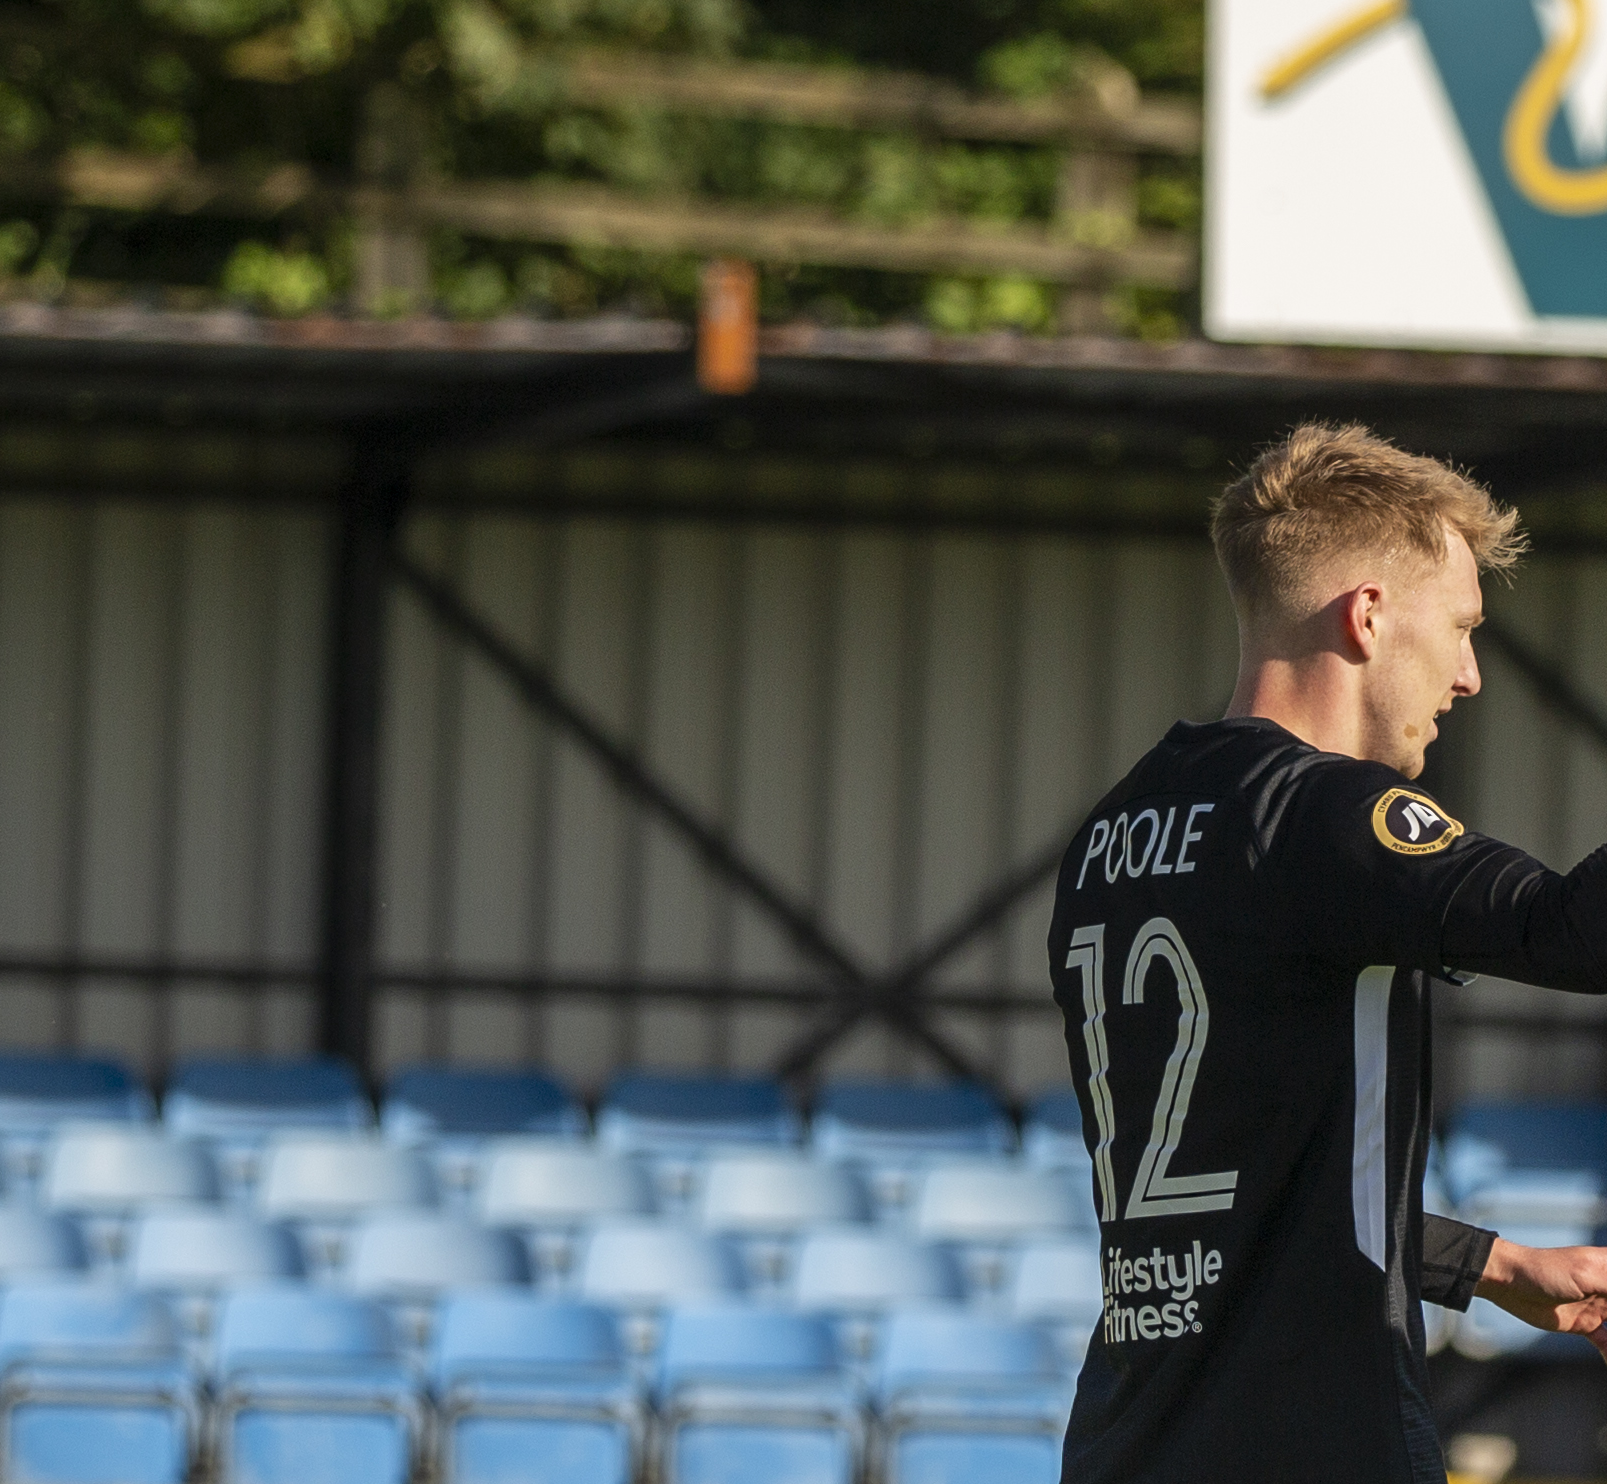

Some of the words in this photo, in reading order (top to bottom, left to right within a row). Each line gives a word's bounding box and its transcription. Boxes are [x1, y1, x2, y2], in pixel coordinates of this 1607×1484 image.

[1076, 804, 1215, 889] POOLE
[1065, 917, 1239, 1222] 12
[1101, 1240, 1223, 1300] Lifestyle
